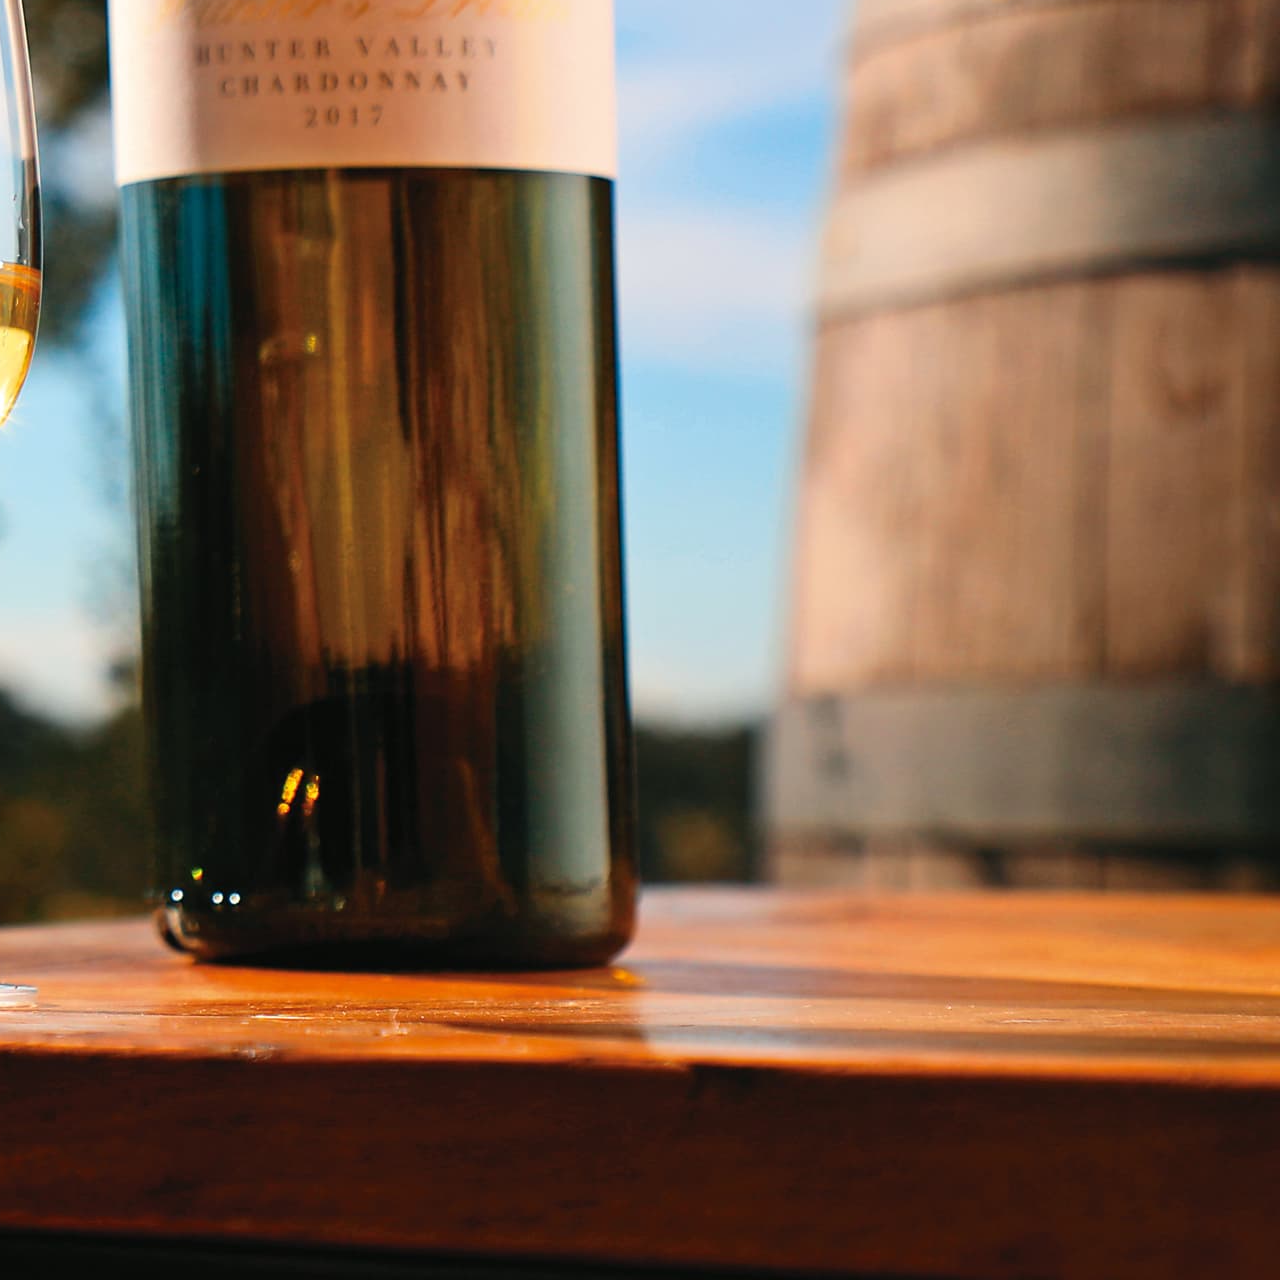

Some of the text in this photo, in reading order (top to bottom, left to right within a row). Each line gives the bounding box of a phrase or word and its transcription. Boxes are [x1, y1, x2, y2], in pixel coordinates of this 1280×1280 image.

[195, 36, 501, 65] HUNTER VALLEY
[220, 72, 473, 98] CHARDONNAY
[305, 105, 385, 129] 2017
